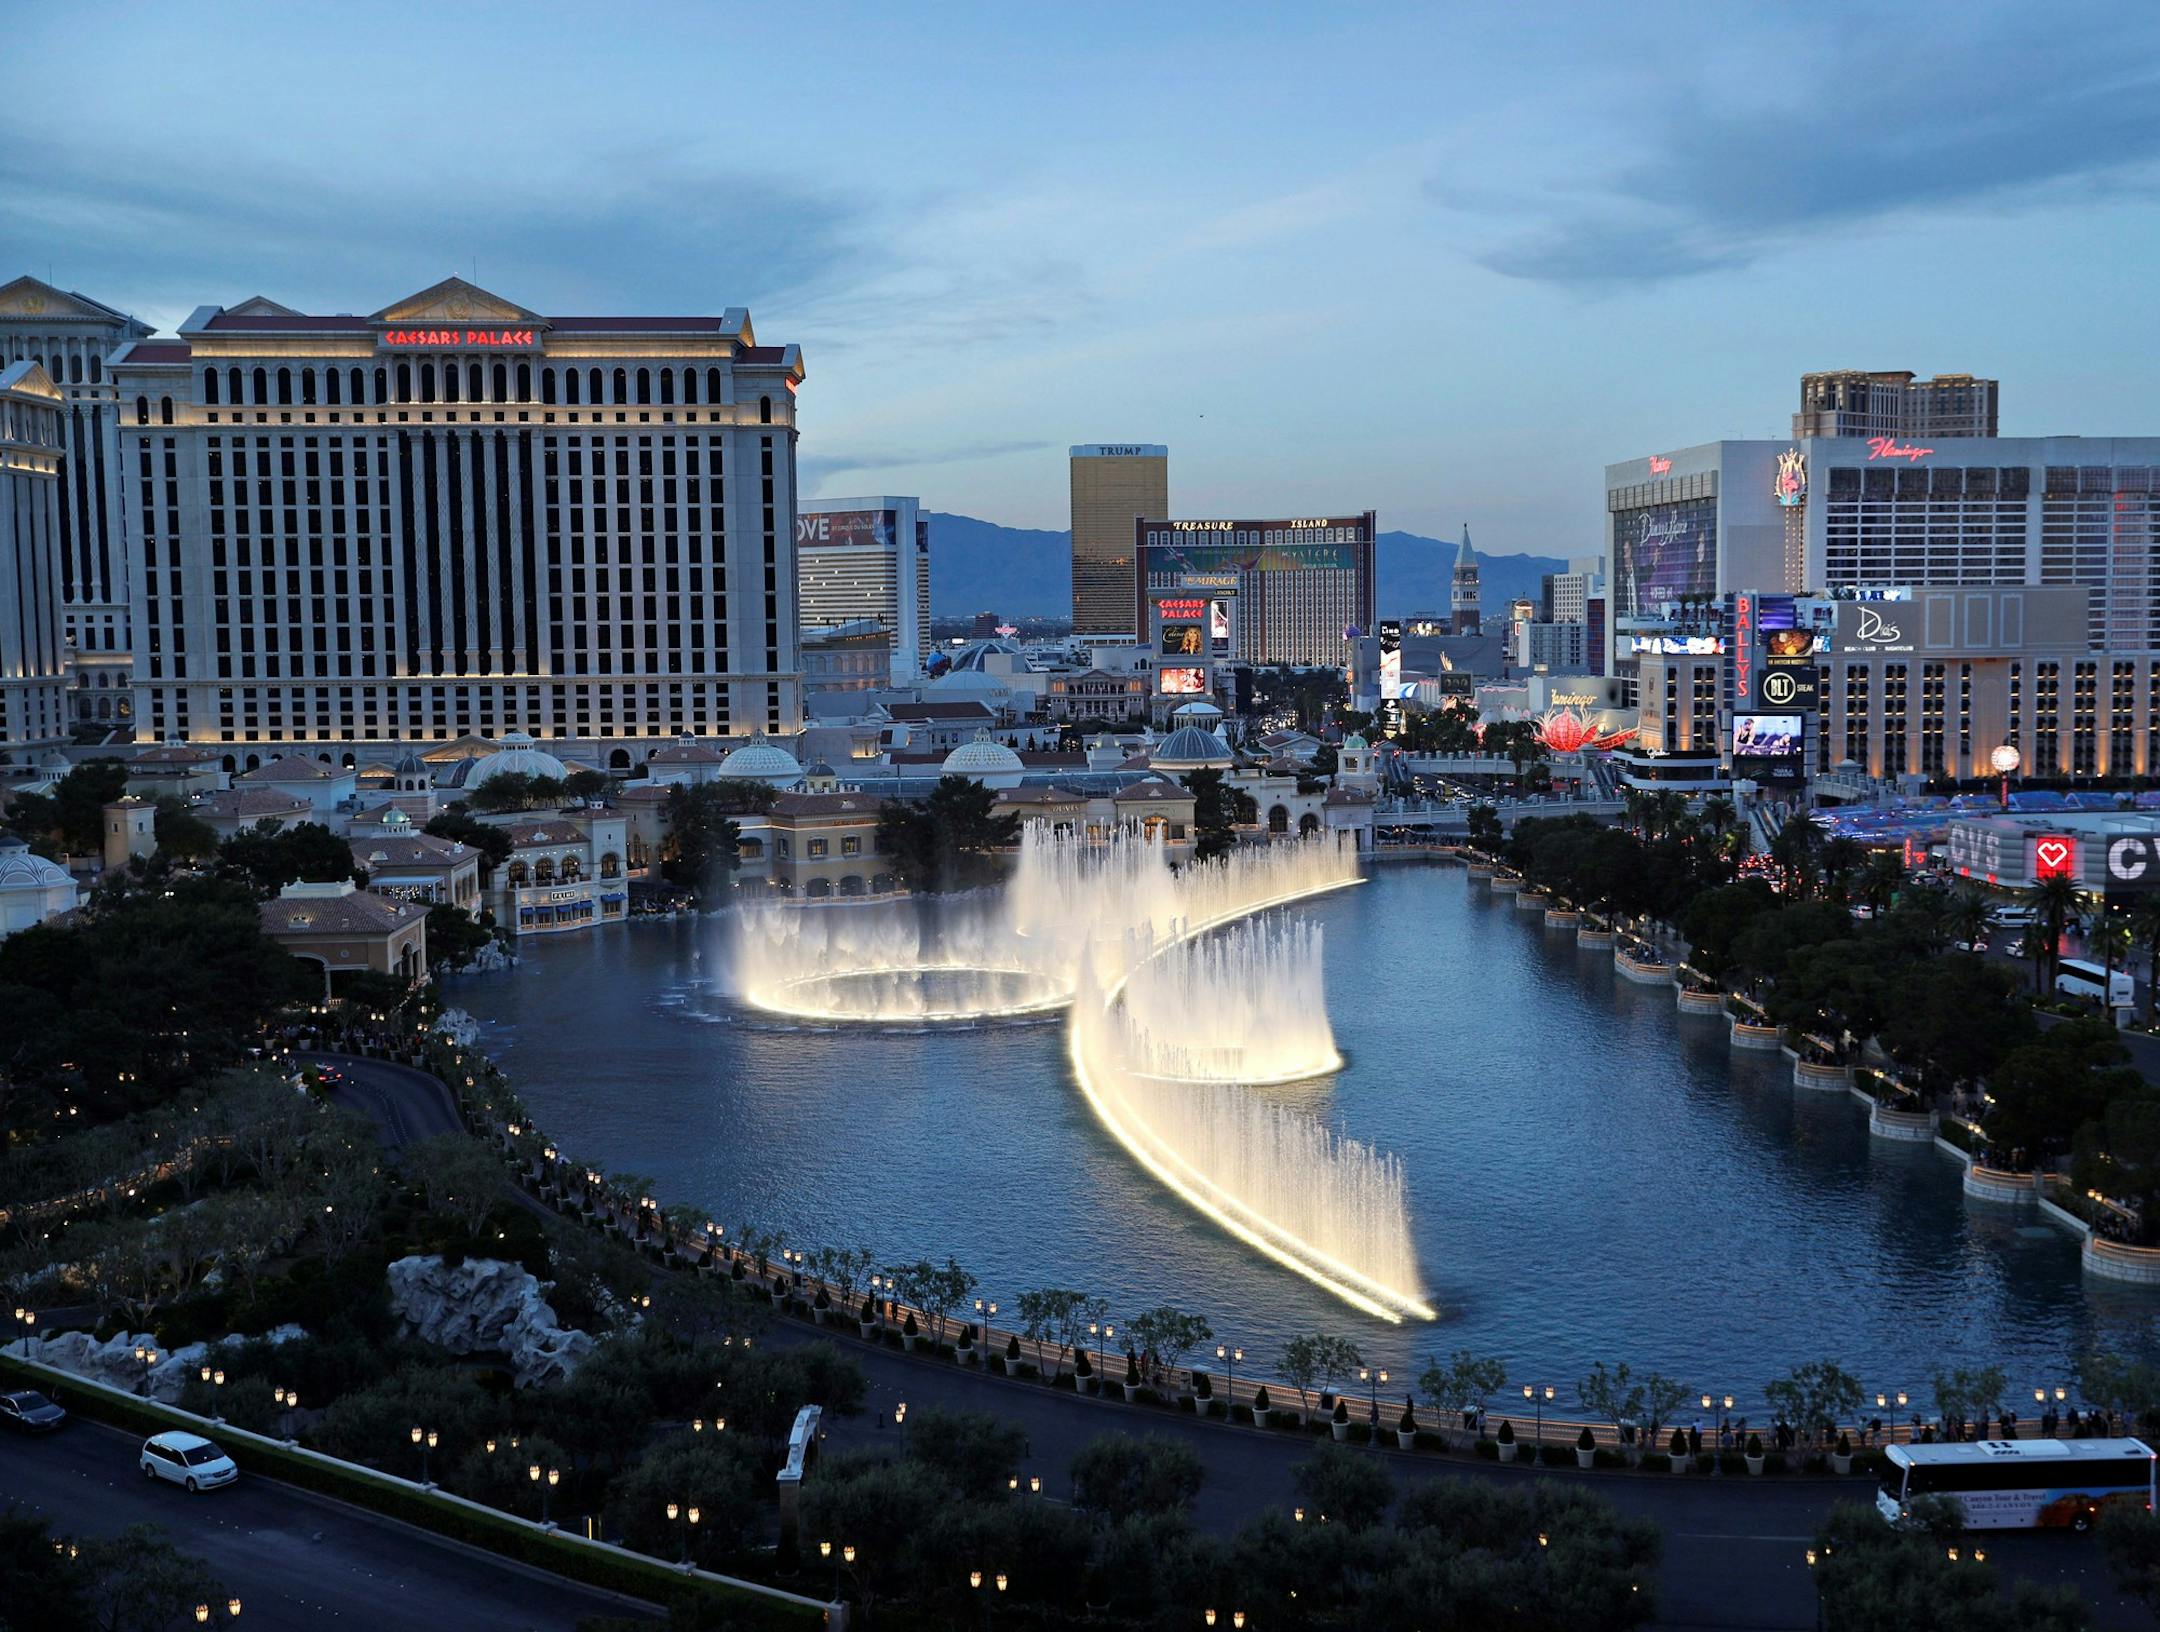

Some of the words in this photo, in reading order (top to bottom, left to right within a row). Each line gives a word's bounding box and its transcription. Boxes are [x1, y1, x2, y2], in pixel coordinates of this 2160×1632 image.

[385, 330, 460, 345] CAESARS
[466, 330, 534, 345] PALACE
[1100, 446, 1142, 456] TRUMP
[1867, 436, 1934, 462] Flamingo
[1173, 521, 1234, 531] TREASURE
[1290, 519, 1328, 529] ISLAND
[1158, 600, 1206, 609] CAESARS
[1161, 609, 1204, 618] PALACE
[1770, 679, 1790, 697] BLT
[1950, 824, 2000, 872] CVS
[2108, 837, 2160, 880] C
